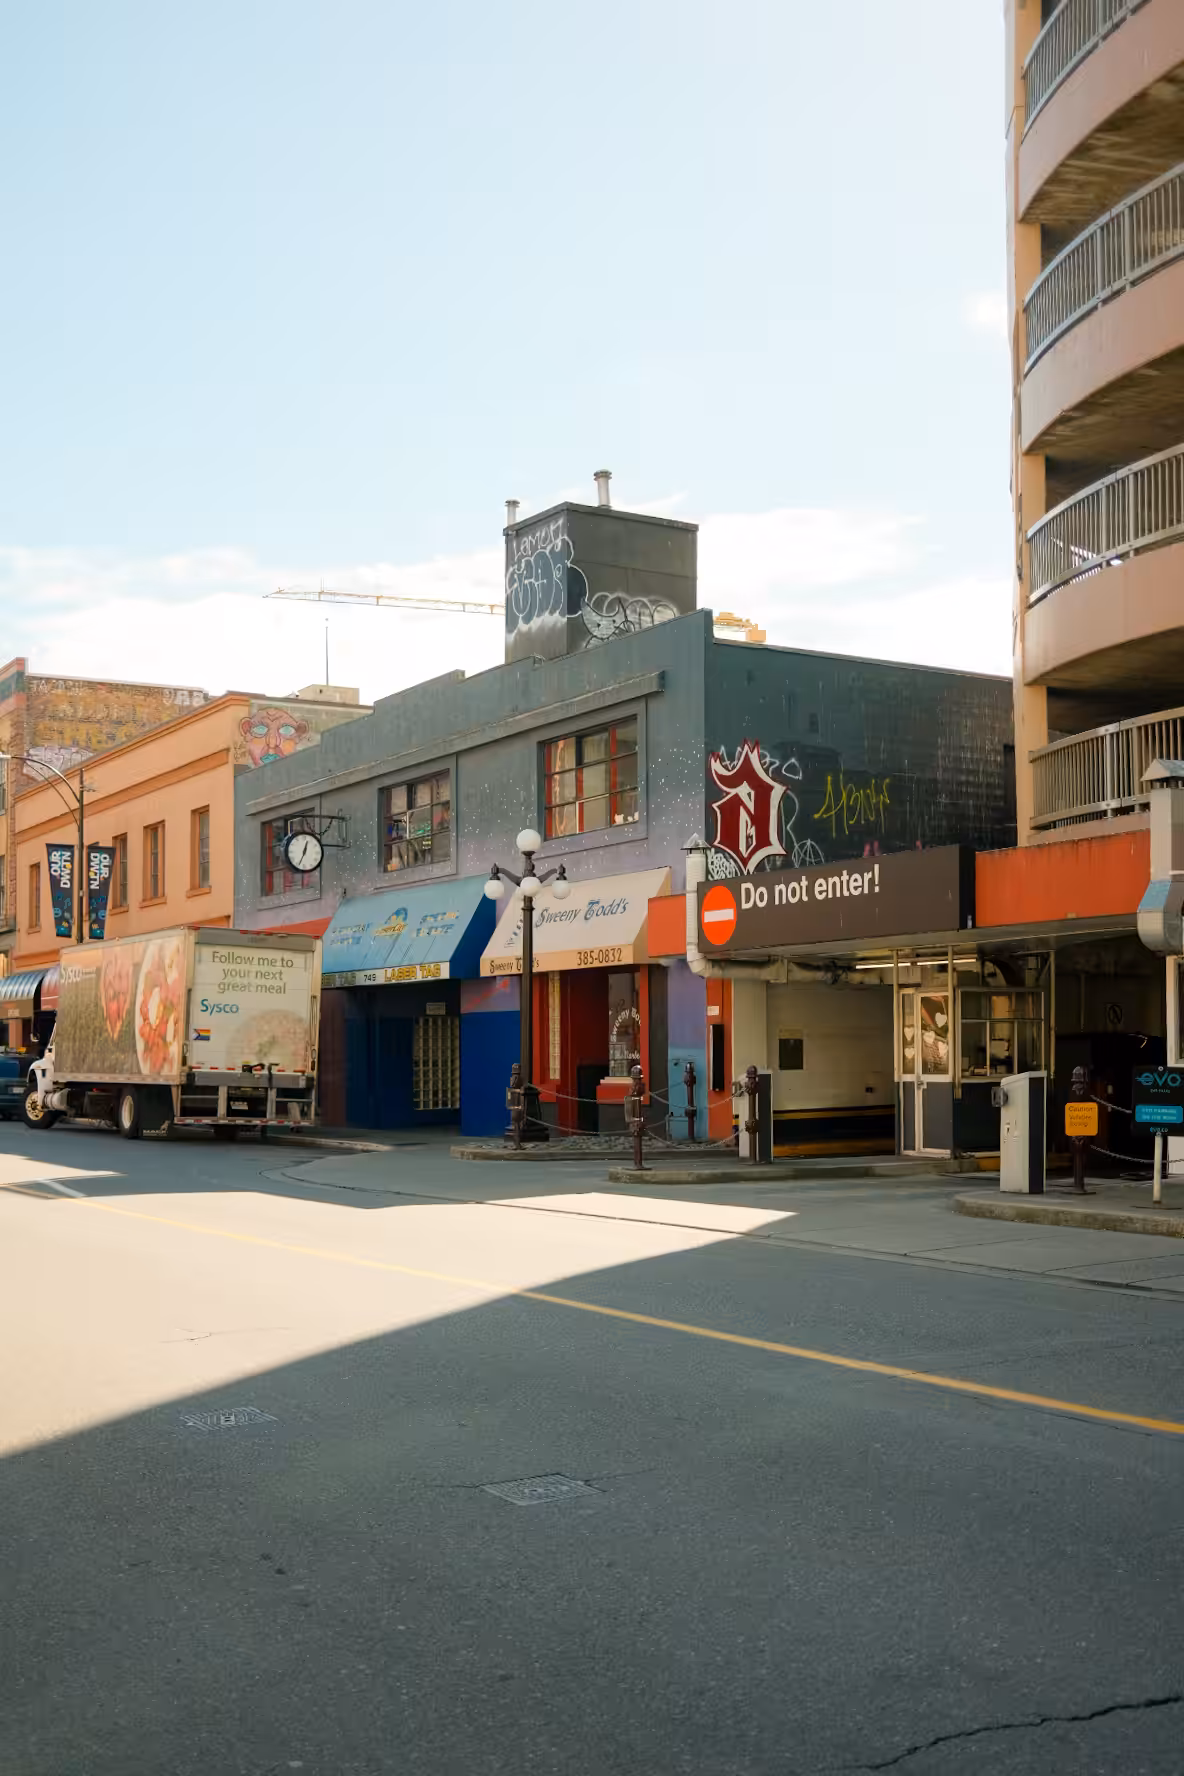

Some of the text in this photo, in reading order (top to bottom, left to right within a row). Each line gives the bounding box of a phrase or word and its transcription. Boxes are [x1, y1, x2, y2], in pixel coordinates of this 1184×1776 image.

[51, 851, 60, 876] OUR
[101, 854, 110, 878] OUR
[740, 863, 880, 910] Do not enter!
[535, 898, 629, 928] Sweeny Todd's
[212, 951, 294, 968] Follow me to
[577, 947, 623, 966] 385-0832
[222, 968, 283, 981] your next
[363, 973, 377, 983] 749
[384, 964, 441, 983] LASER TAG
[217, 981, 287, 994] great meal
[200, 998, 239, 1016] Sysco
[1135, 1071, 1181, 1086] evo
